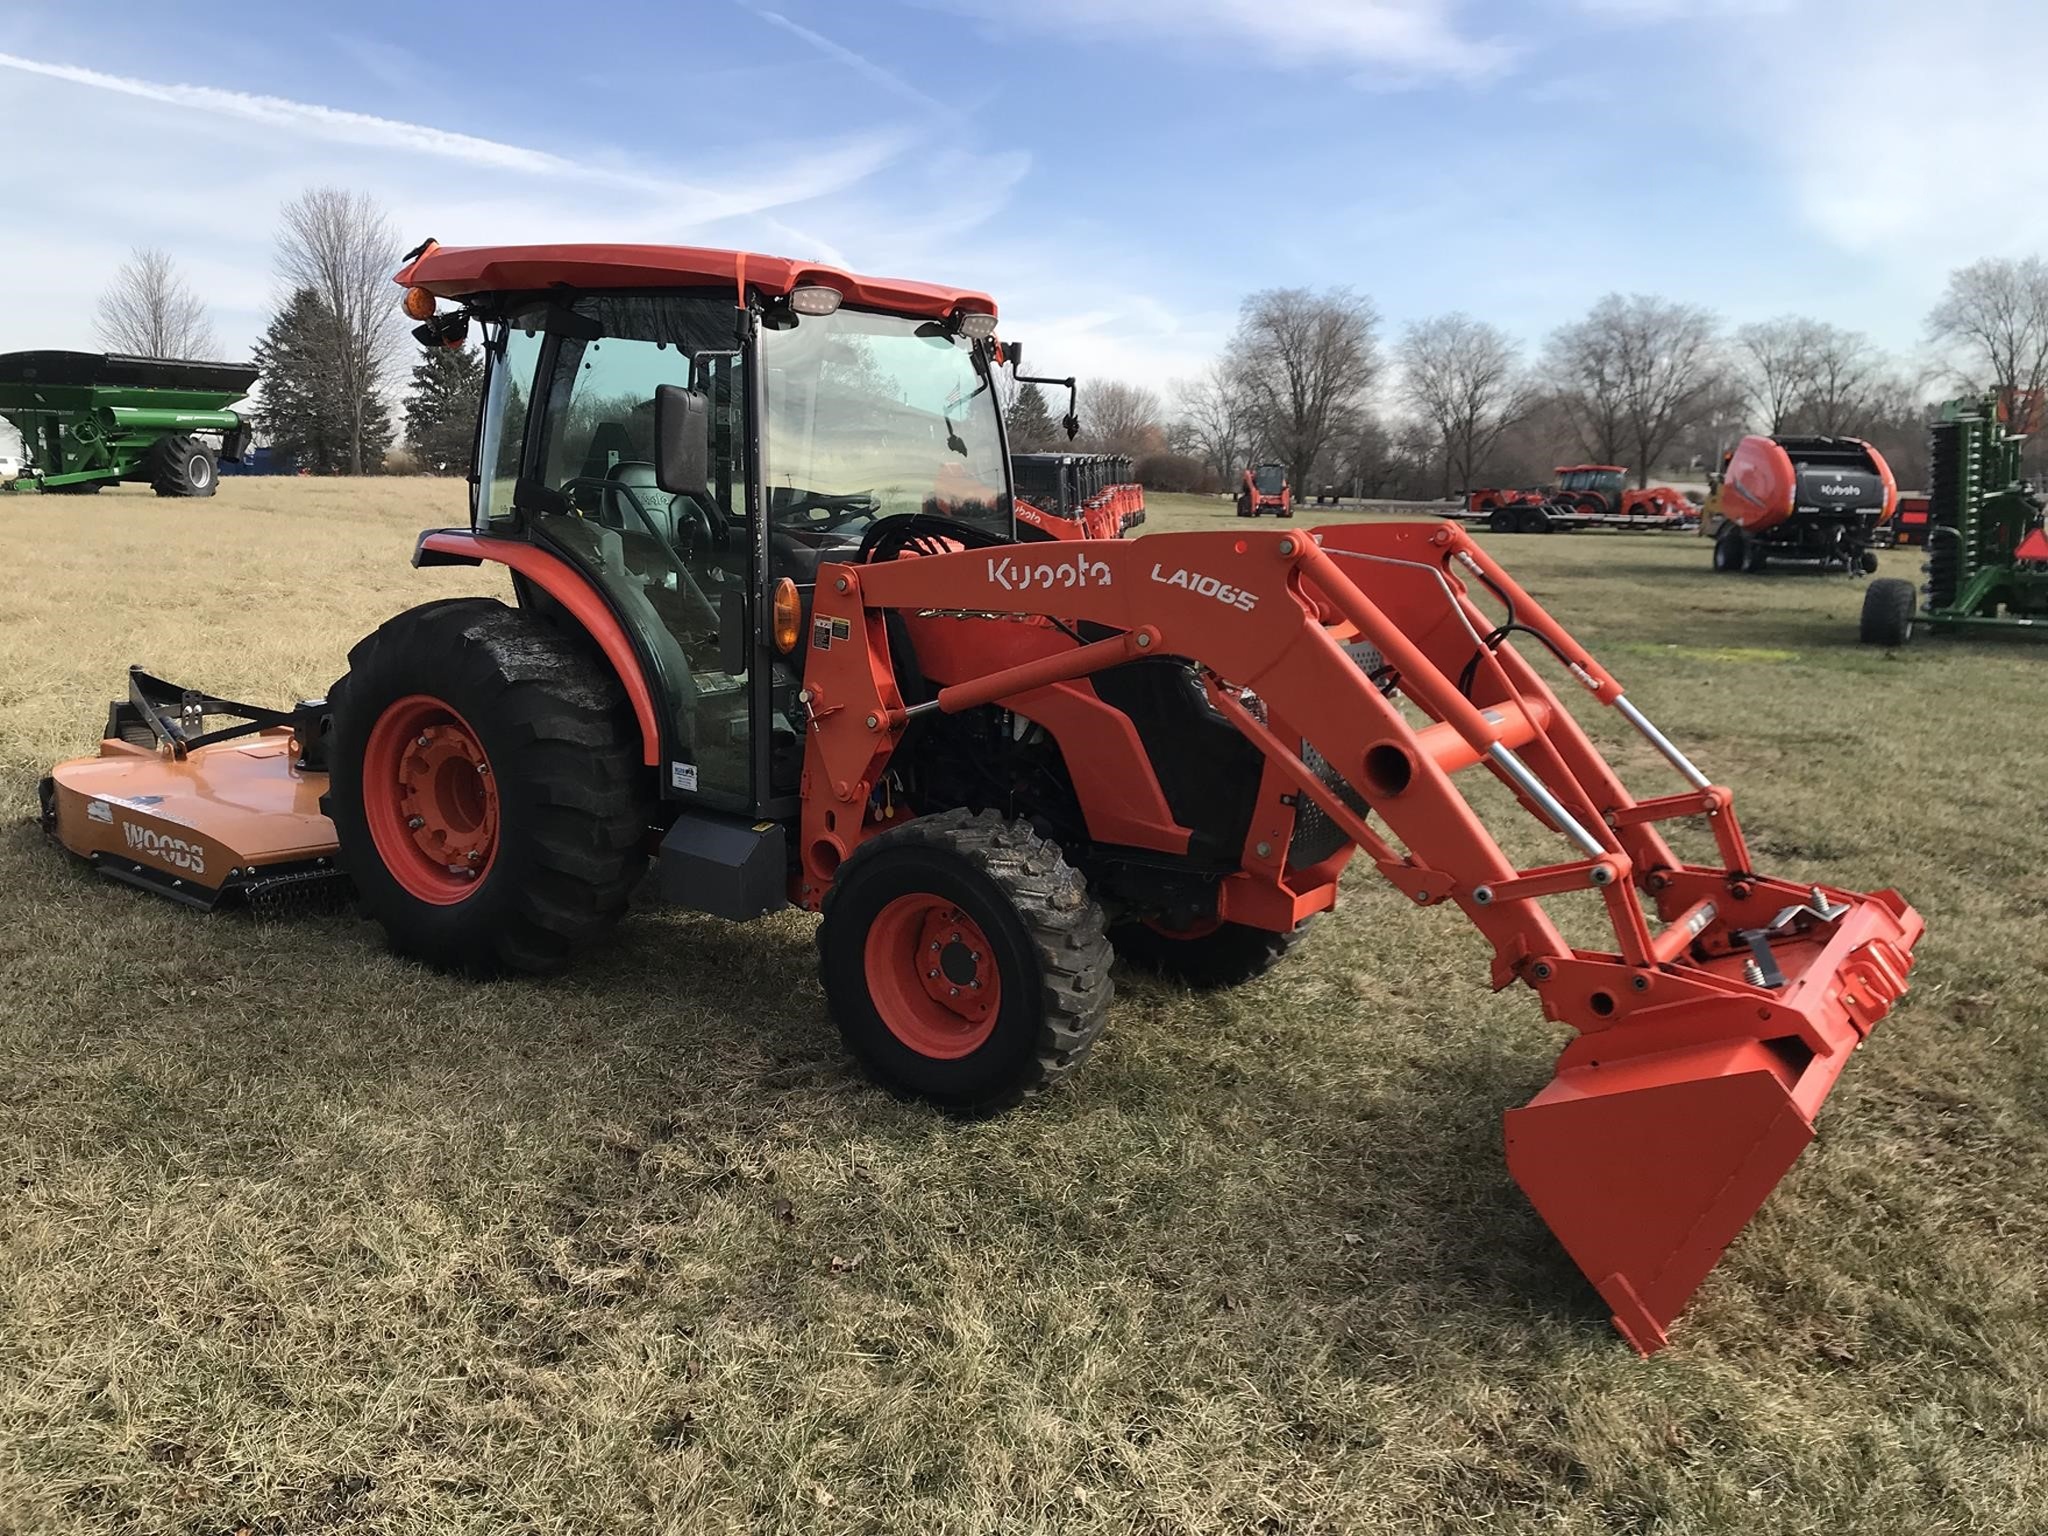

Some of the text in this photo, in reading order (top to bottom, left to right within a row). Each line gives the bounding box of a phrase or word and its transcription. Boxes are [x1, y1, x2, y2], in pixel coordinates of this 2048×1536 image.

[1821, 484, 1861, 496] Kubota
[1014, 505, 1041, 524] ubota
[987, 552, 1112, 591] Kubota
[1150, 562, 1260, 612] LA1065
[122, 821, 205, 874] WOODS
